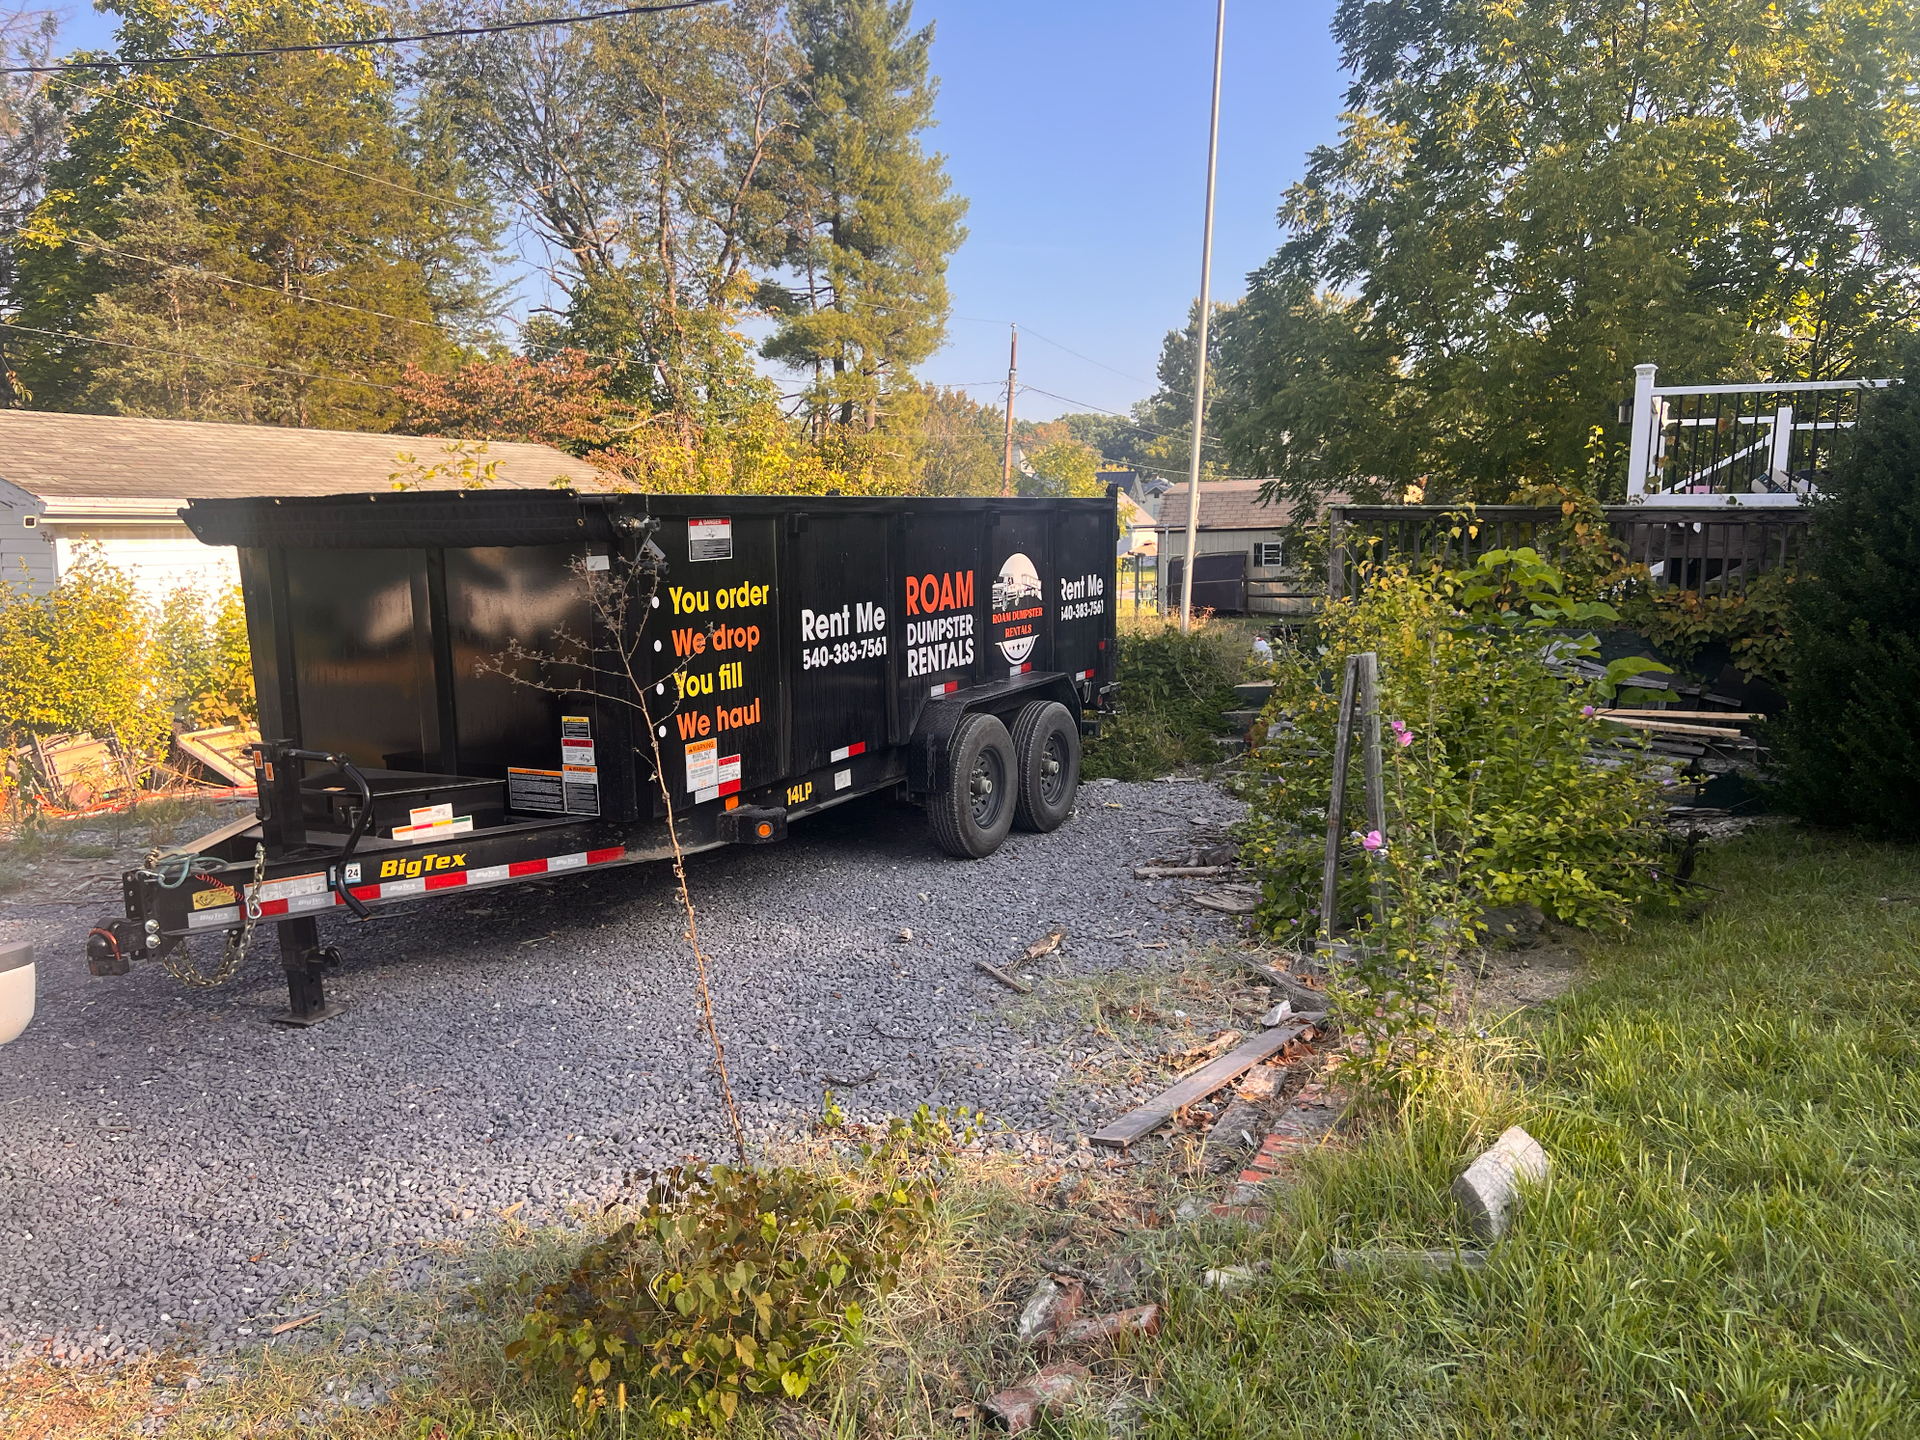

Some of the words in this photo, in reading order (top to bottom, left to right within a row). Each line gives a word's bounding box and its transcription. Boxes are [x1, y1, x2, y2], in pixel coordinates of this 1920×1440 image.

[668, 586, 710, 615] You
[715, 580, 770, 610] order
[906, 570, 974, 616] ROAM
[1087, 573, 1104, 597] Me
[801, 604, 851, 642] Rent
[856, 601, 886, 634] Me
[907, 614, 974, 646] DUMPSTER
[992, 612, 1012, 624] ROAM
[1012, 607, 1043, 620] DUMPSTER
[1005, 624, 1032, 638] RENTALS
[671, 627, 706, 657] We
[712, 623, 760, 652] drop
[803, 636, 887, 670] 540-383-7561
[907, 638, 974, 678] RENTALS
[673, 670, 714, 699] You
[719, 661, 743, 691] fill
[676, 711, 711, 741] We
[716, 697, 761, 732] haul
[786, 781, 813, 806] 14LP
[347, 868, 359, 878] 24
[380, 853, 467, 879] BigTex
